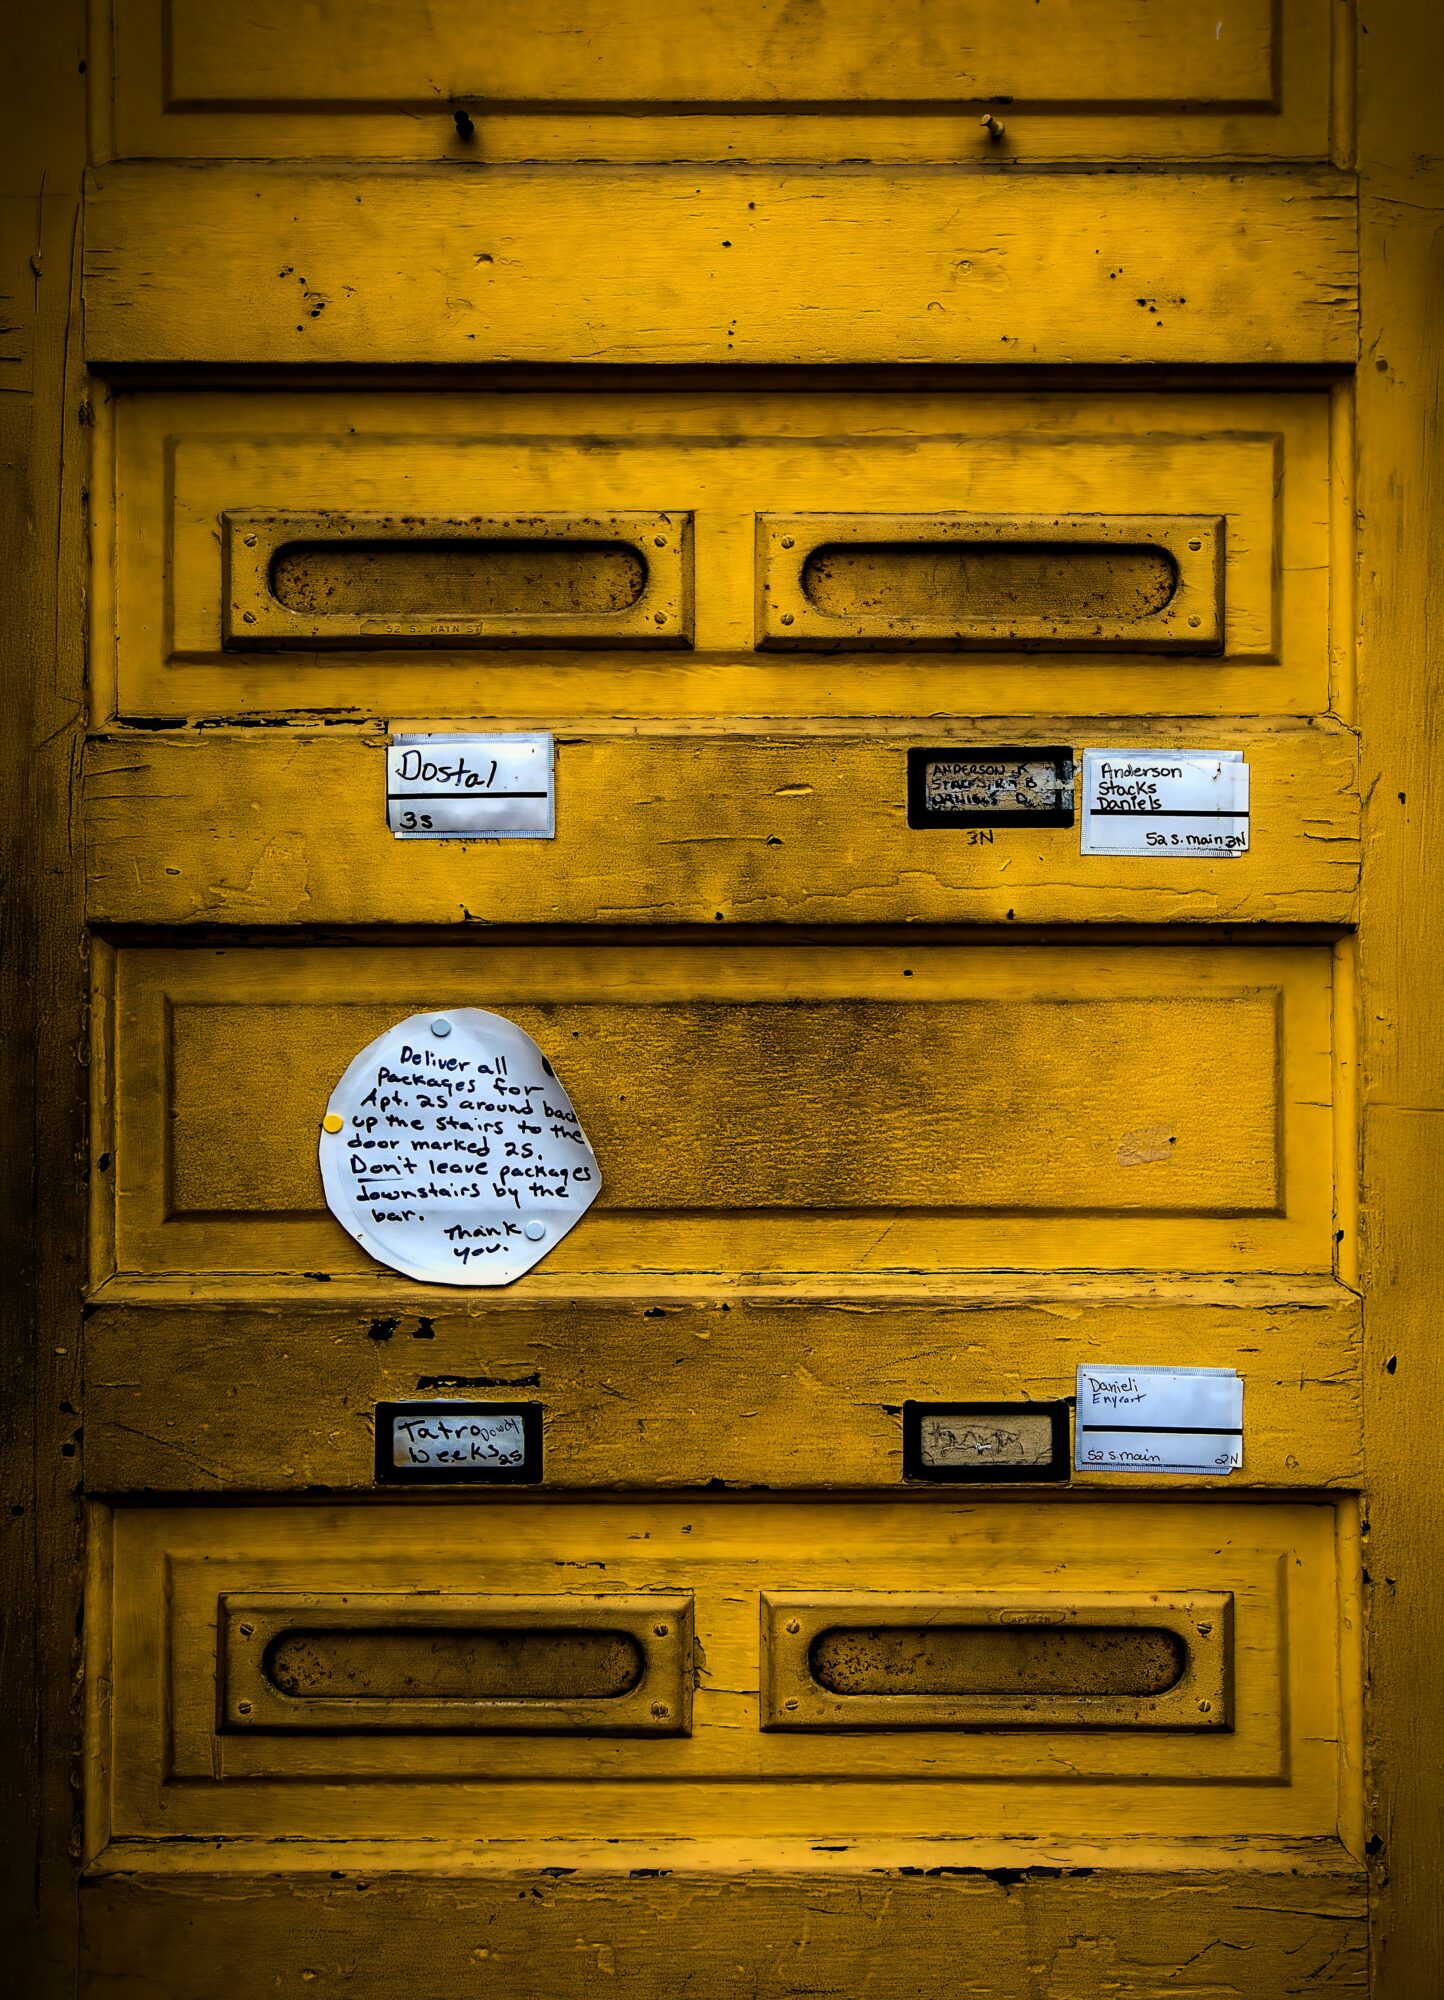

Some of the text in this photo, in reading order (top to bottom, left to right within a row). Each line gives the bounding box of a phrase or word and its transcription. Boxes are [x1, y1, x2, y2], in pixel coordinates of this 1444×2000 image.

[386, 625, 401, 633] 52
[430, 625, 460, 633] MAIN
[395, 750, 497, 788] Dostal
[933, 764, 1006, 777] ANDERSON
[1101, 763, 1182, 779] Anderson
[1097, 795, 1162, 811] Daniels
[967, 829, 994, 846] 3N
[1146, 832, 1168, 846] 52
[400, 1046, 508, 1075] Deliver all
[493, 1078, 544, 1096] for
[360, 1088, 409, 1112] Apt.
[459, 1099, 533, 1115] around
[352, 1116, 378, 1133] up
[386, 1114, 424, 1130] the
[518, 1120, 542, 1135] to
[550, 1124, 585, 1144] the
[347, 1133, 400, 1150] door
[411, 1136, 490, 1157] marked
[350, 1154, 592, 1186] Don't leave packages
[356, 1182, 569, 1209] downstairs by the
[371, 1208, 425, 1223] bar.
[453, 1243, 509, 1264] you.
[398, 1417, 520, 1442] Tatro Dowdy
[1214, 1453, 1239, 1465] 2N
